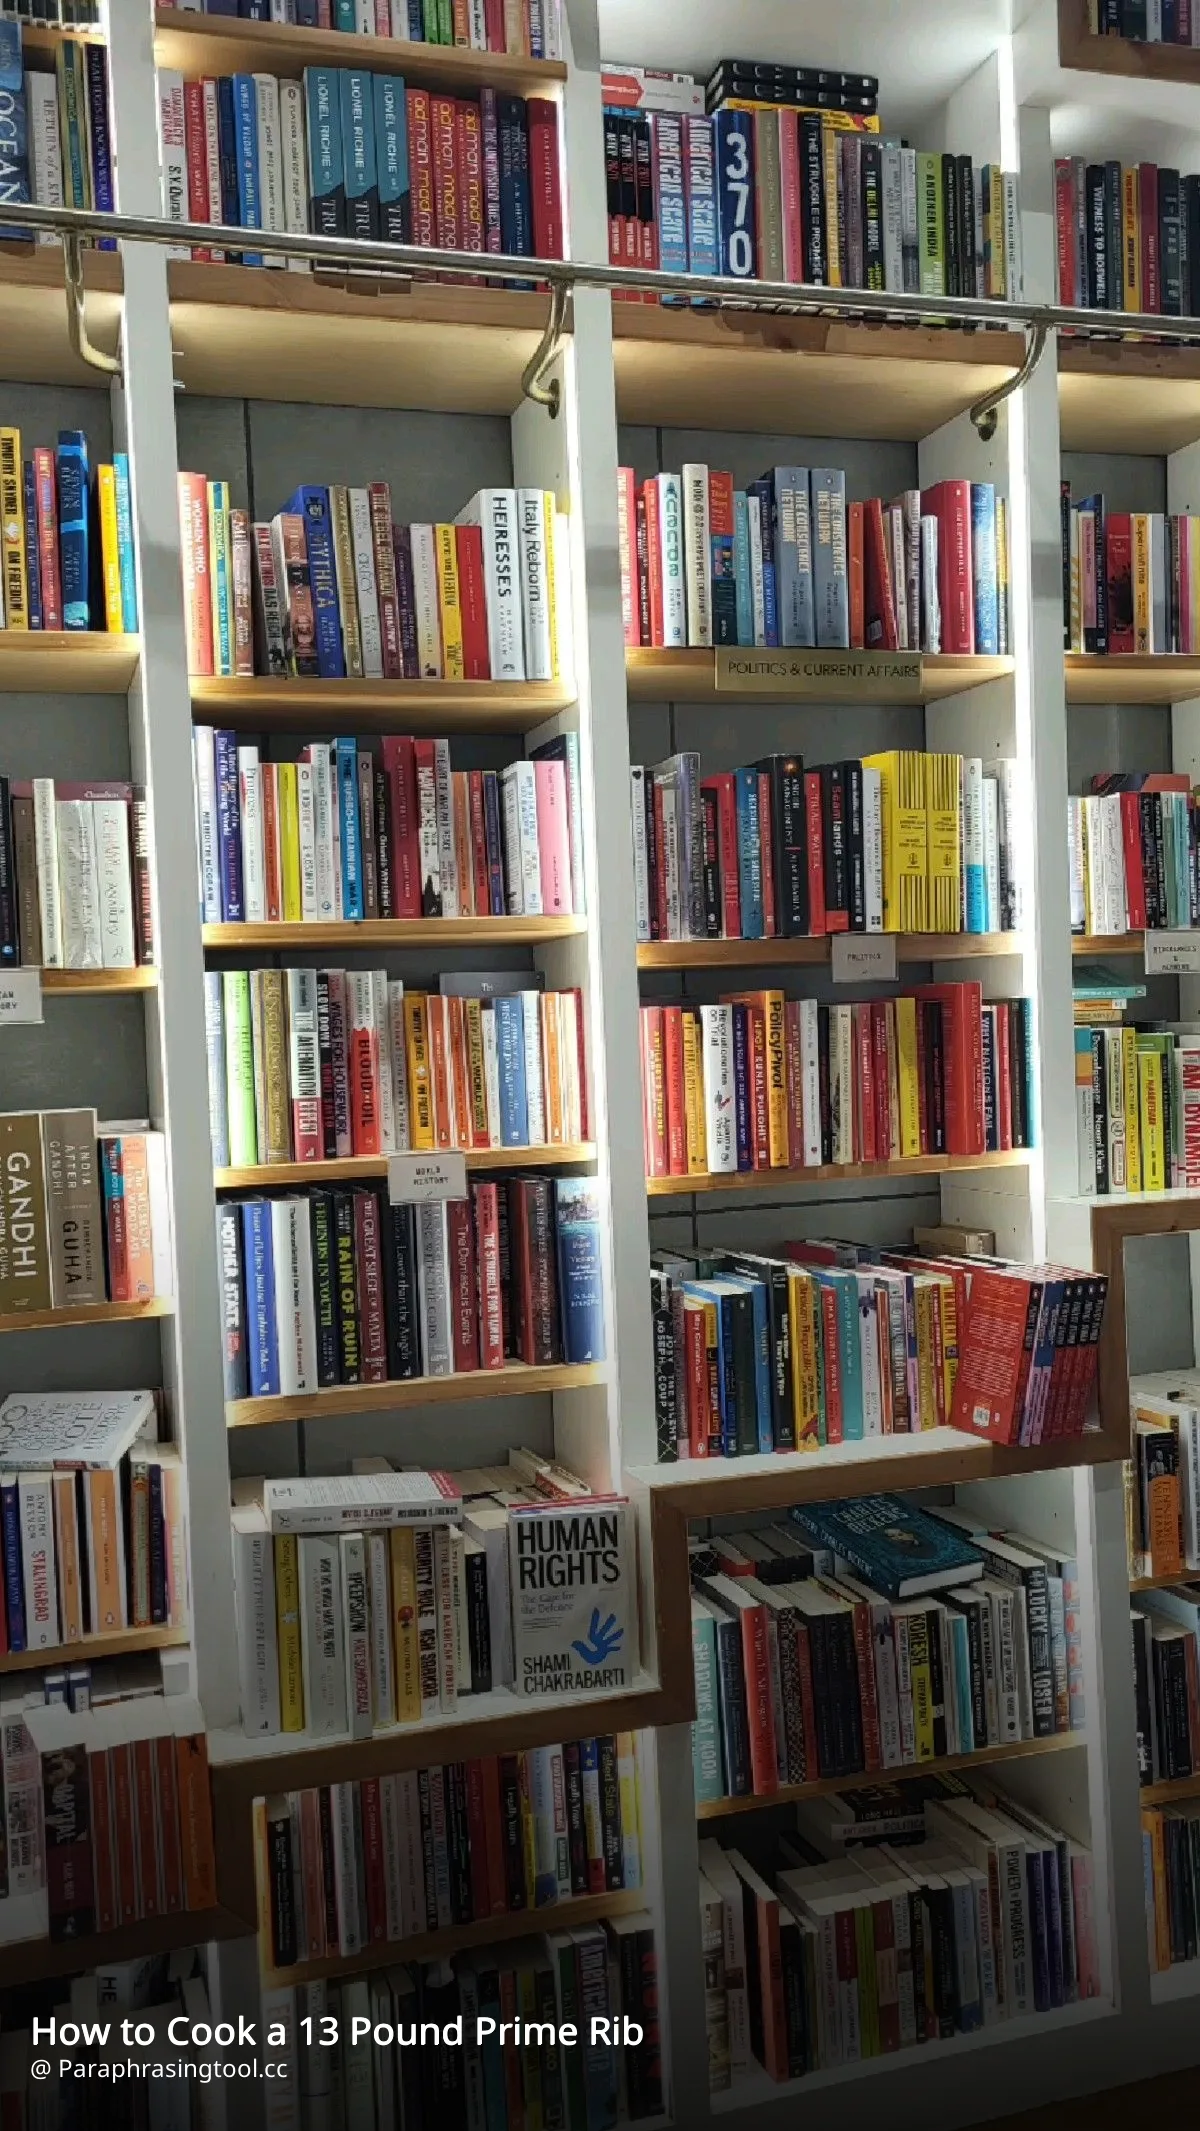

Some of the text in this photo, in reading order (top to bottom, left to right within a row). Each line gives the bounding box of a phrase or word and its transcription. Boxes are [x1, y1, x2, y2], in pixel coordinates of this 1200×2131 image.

[0, 91, 24, 204] OCEAN
[44, 99, 59, 206] RETURN of a KIN
[319, 75, 337, 237] LIONEL RICHIE TRU
[351, 78, 369, 240] LIONEL RICHIE TRU
[383, 83, 402, 241] LIONEL RICHIE TRU
[415, 97, 429, 164] adman
[657, 118, 685, 243] American scare
[689, 119, 715, 245] American scare
[725, 132, 753, 275] 370
[808, 155, 821, 214] STRUGGLE
[925, 174, 938, 257] ANOTHER INDIA
[1093, 187, 1106, 301] WITNESS TO ROSWELL
[1, 437, 24, 612] TIMOTHY SNYDER ON FREEDOM
[781, 488, 796, 543] NETWORK
[795, 489, 808, 510] THE
[817, 490, 832, 545] NETWORK
[829, 492, 842, 512] THE
[193, 498, 206, 573] WOMEN WHO
[492, 496, 511, 598] HEIRESSES
[522, 499, 542, 602] Italy Reborn
[264, 588, 277, 608] DAS
[310, 532, 335, 609] MYTHICA
[266, 611, 280, 639] REICH
[728, 661, 919, 678] POLITICS & CURRENT AFFAIRS
[792, 778, 800, 809] ANGER
[831, 785, 844, 856] Scamlands
[343, 757, 357, 906] THE RUSSO-UKRAINIAN WAR
[294, 1009, 314, 1031] THE
[709, 1009, 720, 1047] on Trial
[718, 1008, 730, 1086] Revolutionaries
[769, 1000, 785, 1090] Policy Pivot
[330, 1000, 347, 1136] WAGES FOR HOUSEWORK
[358, 1039, 374, 1127] BLOOD OIL
[473, 1065, 482, 1103] WORLD
[981, 1016, 994, 1129] WHY NATIONS FAIL
[1095, 1113, 1105, 1148] Naomi
[1095, 1149, 1105, 1174] Klein
[49, 1140, 63, 1195] GANDHI
[64, 1144, 77, 1189] AFTER
[80, 1144, 92, 1186] INDIA
[413, 1176, 449, 1186] HISTORY
[415, 1165, 441, 1176] WORLD
[6, 1151, 38, 1277] GANDHI
[363, 1200, 374, 1218] THE
[363, 1218, 376, 1260] GREAT
[62, 1219, 82, 1285] GUHA
[221, 1215, 240, 1328] MOTHER STATE
[315, 1201, 332, 1326] FRIENDS IN YOUTH
[365, 1261, 378, 1295] SIEGE
[457, 1223, 473, 1346] The Damascus Events
[337, 1235, 358, 1367] RAIN OF RUIN
[368, 1311, 381, 1352] MALTA
[396, 1245, 411, 1360] Lower than the Angels
[656, 1319, 666, 1365] JOSEPH
[666, 1335, 674, 1362] JOSY
[658, 1374, 667, 1407] COUP
[668, 1374, 677, 1440] THE SILENT
[38, 1494, 47, 1537] ANTONY
[517, 1515, 618, 1555] HUMAN
[1153, 1481, 1164, 1546] WILLIAMS
[1162, 1480, 1174, 1545] TENNESSEE
[31, 1549, 49, 1622] STALINGRAD
[441, 1548, 450, 1564] THE
[519, 1550, 621, 1590] RIGHTS
[415, 1530, 439, 1700] MINORITY RULE ASH SARKAR
[442, 1592, 452, 1611] FOR
[442, 1613, 454, 1661] AMERICAN
[523, 1652, 571, 1675] SHAMI
[1029, 1588, 1053, 1716] LUCKY LOSER
[445, 1663, 455, 1695] POWER
[524, 1668, 625, 1694] CHAKRABARTI
[694, 1642, 717, 1780] SHADOWS AT NOON
[1006, 1850, 1026, 1961] POWER PROGRESS
